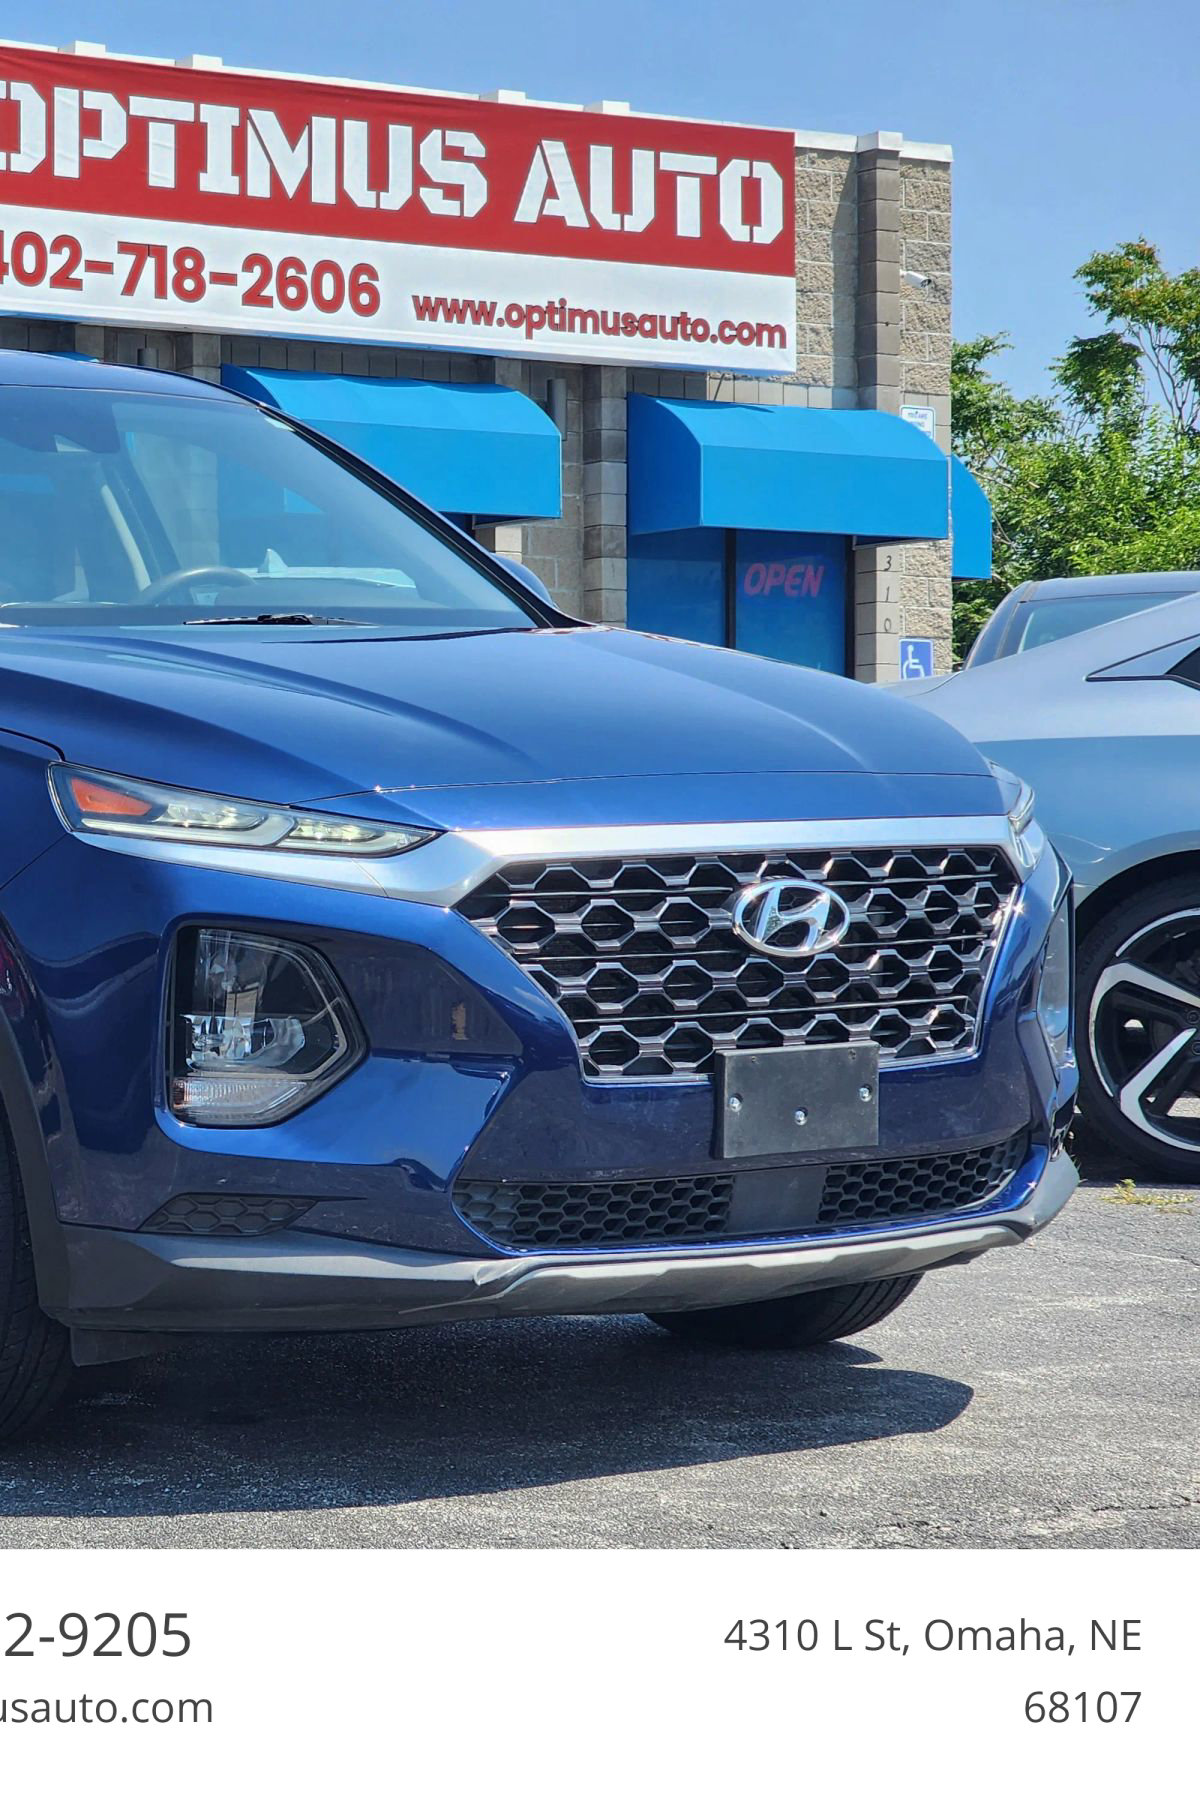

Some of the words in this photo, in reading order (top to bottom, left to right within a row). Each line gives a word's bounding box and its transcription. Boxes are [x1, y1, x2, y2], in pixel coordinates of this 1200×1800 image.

[513, 138, 784, 245] AUTO
[411, 294, 788, 350] www.optimusauto.com
[743, 562, 825, 598] OPEN
